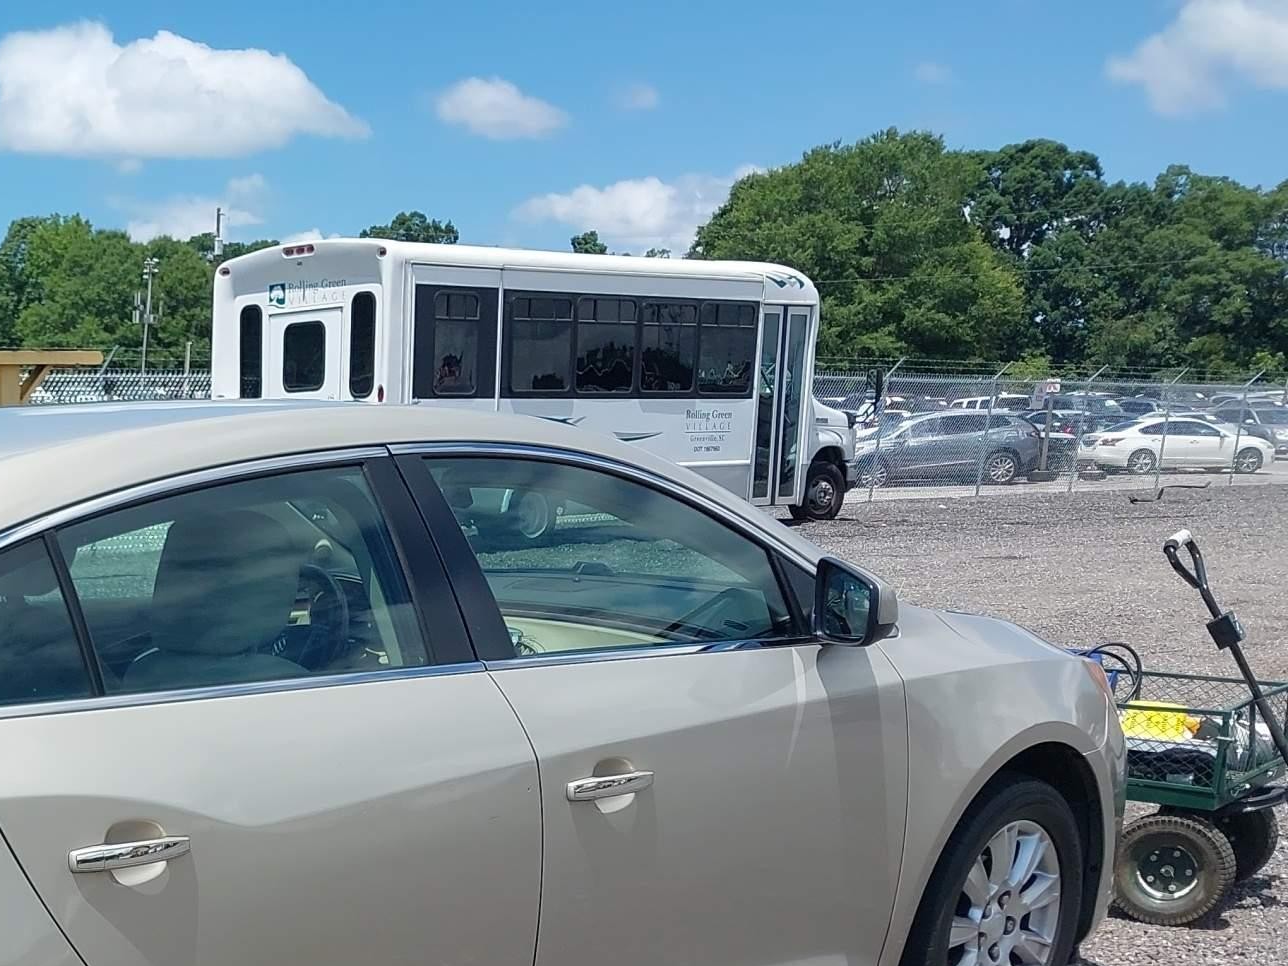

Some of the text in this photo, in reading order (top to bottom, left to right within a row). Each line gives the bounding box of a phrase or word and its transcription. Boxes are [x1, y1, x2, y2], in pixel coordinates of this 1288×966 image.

[288, 279, 346, 294] Rolling Green
[686, 409, 732, 422] Rolling Green
[685, 422, 731, 431] VILLAGE
